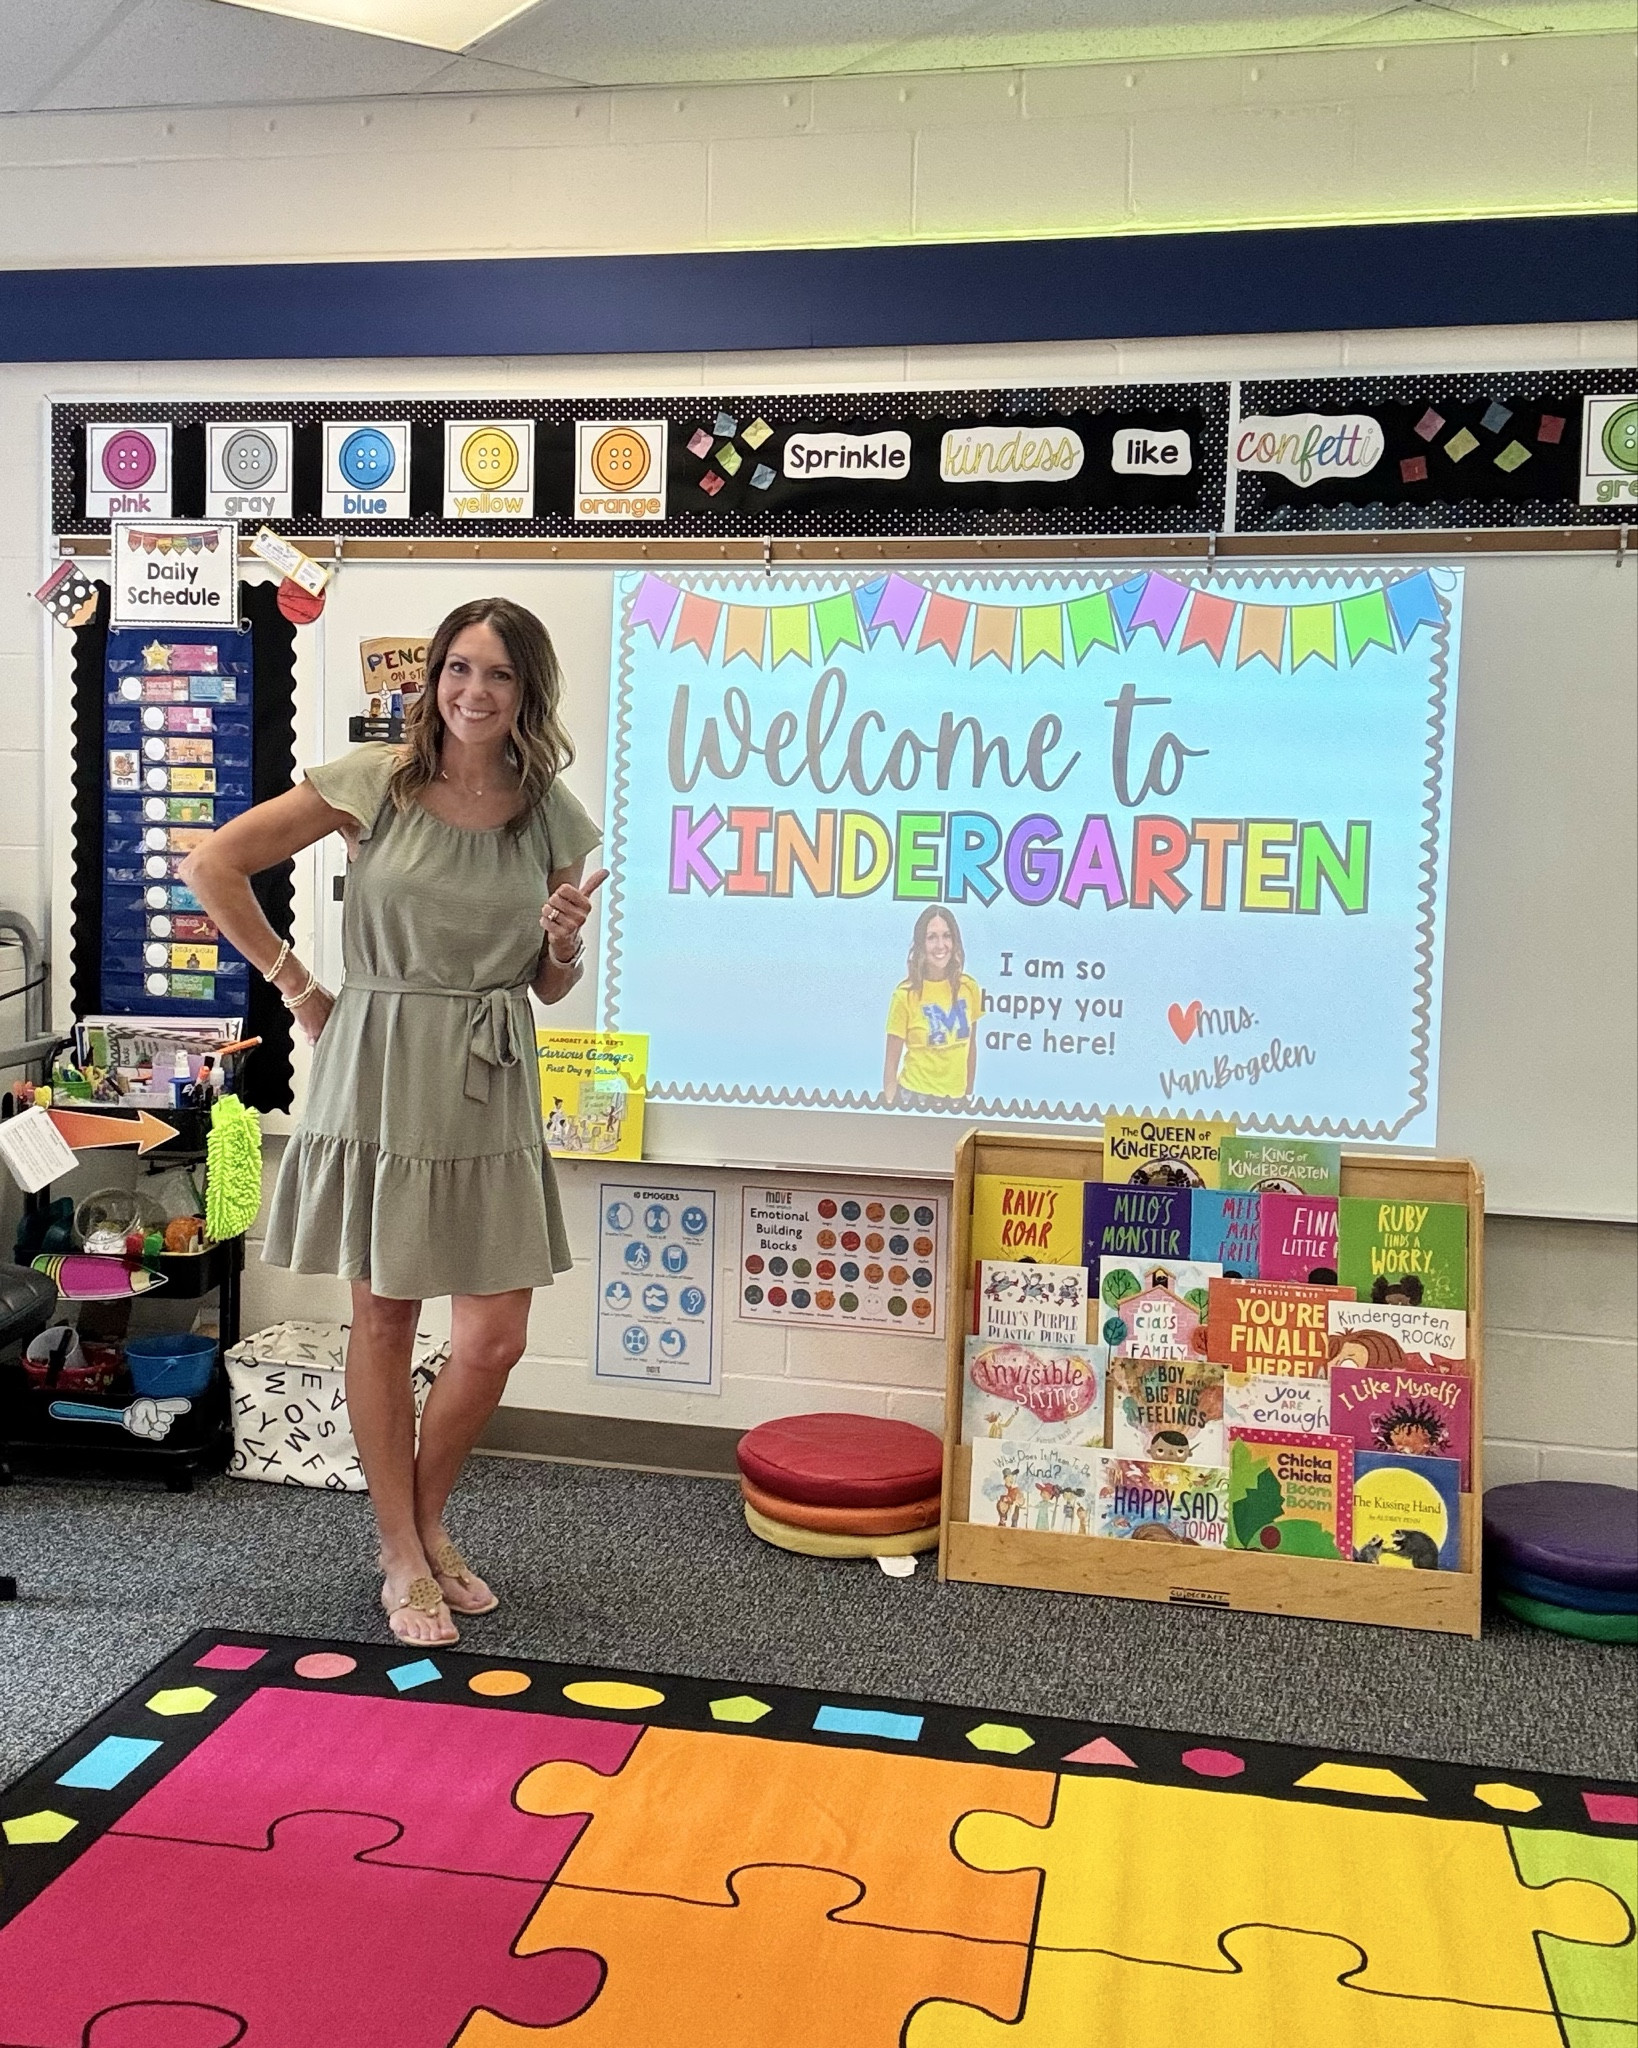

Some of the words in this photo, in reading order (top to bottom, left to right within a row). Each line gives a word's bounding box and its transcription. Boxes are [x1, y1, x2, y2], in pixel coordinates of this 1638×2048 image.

[790, 443, 906, 474] Sprinkle
[1126, 440, 1179, 465] like
[1236, 424, 1380, 483] confetti
[108, 493, 152, 516] pink
[224, 495, 276, 516] gray
[343, 493, 388, 515] blue
[453, 492, 524, 517] yellow
[579, 497, 662, 518] orange
[147, 562, 199, 584] Daily
[127, 586, 221, 607] Schedule
[390, 670, 406, 682] ON
[667, 667, 1082, 796] Welcome
[1103, 683, 1211, 808] to
[668, 803, 1372, 916] KINDERGARTEN
[999, 952, 1014, 977] I
[1023, 957, 1064, 980] am
[1076, 959, 1106, 980] so
[981, 988, 1062, 1020] happy
[1074, 996, 1123, 1021] you
[538, 1045, 584, 1060] Curious
[985, 1029, 1031, 1052] are
[1043, 1029, 1116, 1056] here!
[546, 1063, 565, 1073] First
[566, 1064, 583, 1077] Day
[1120, 1126, 1139, 1138] The
[1140, 1121, 1196, 1143] QUEEN
[1198, 1131, 1212, 1142] of
[1245, 1149, 1260, 1161] The
[1297, 1153, 1309, 1163] of
[750, 1207, 810, 1222] Emotional
[1001, 1187, 1060, 1220] RAVI'S
[1113, 1193, 1175, 1226] MILO'S
[1377, 1203, 1429, 1233] RUBY
[756, 1223, 803, 1240] Building
[1001, 1218, 1053, 1250] ROAR
[1101, 1225, 1181, 1256] MONSTER
[1384, 1233, 1410, 1249] FINDS
[1413, 1236, 1421, 1248] A
[760, 1238, 798, 1252] Blocks
[1281, 1237, 1329, 1258] LITTLE
[1371, 1246, 1433, 1276] WORRY
[987, 1305, 1029, 1327] LILLY'S
[1033, 1309, 1079, 1331] PURPLE
[1235, 1297, 1327, 1329] YOU'RE
[1337, 1310, 1450, 1331] Kindergarten
[1401, 1328, 1456, 1351] ROCKS!
[1131, 1343, 1187, 1361] FAMILY
[981, 1357, 1084, 1388] Invisible
[1158, 1365, 1185, 1384] BOY
[1246, 1355, 1314, 1378] HERE!
[1013, 1384, 1080, 1414] String
[1175, 1387, 1201, 1407] BIG
[1265, 1386, 1311, 1404] you
[1338, 1392, 1355, 1411] I
[1351, 1377, 1392, 1402] Like
[1394, 1375, 1462, 1410] Myself!
[1281, 1400, 1304, 1411] ARE
[1137, 1405, 1207, 1429] FEELINGS
[1253, 1405, 1329, 1433] enough
[1026, 1461, 1062, 1480] Kind?
[1277, 1452, 1333, 1470] Chicka
[1277, 1467, 1333, 1484] Chicka
[1114, 1485, 1219, 1523] HAPPY-SAD
[1353, 1494, 1372, 1508] The
[1374, 1496, 1411, 1513] Kissing
[1412, 1500, 1442, 1515] Hand
[1182, 1521, 1225, 1545] TODAY
